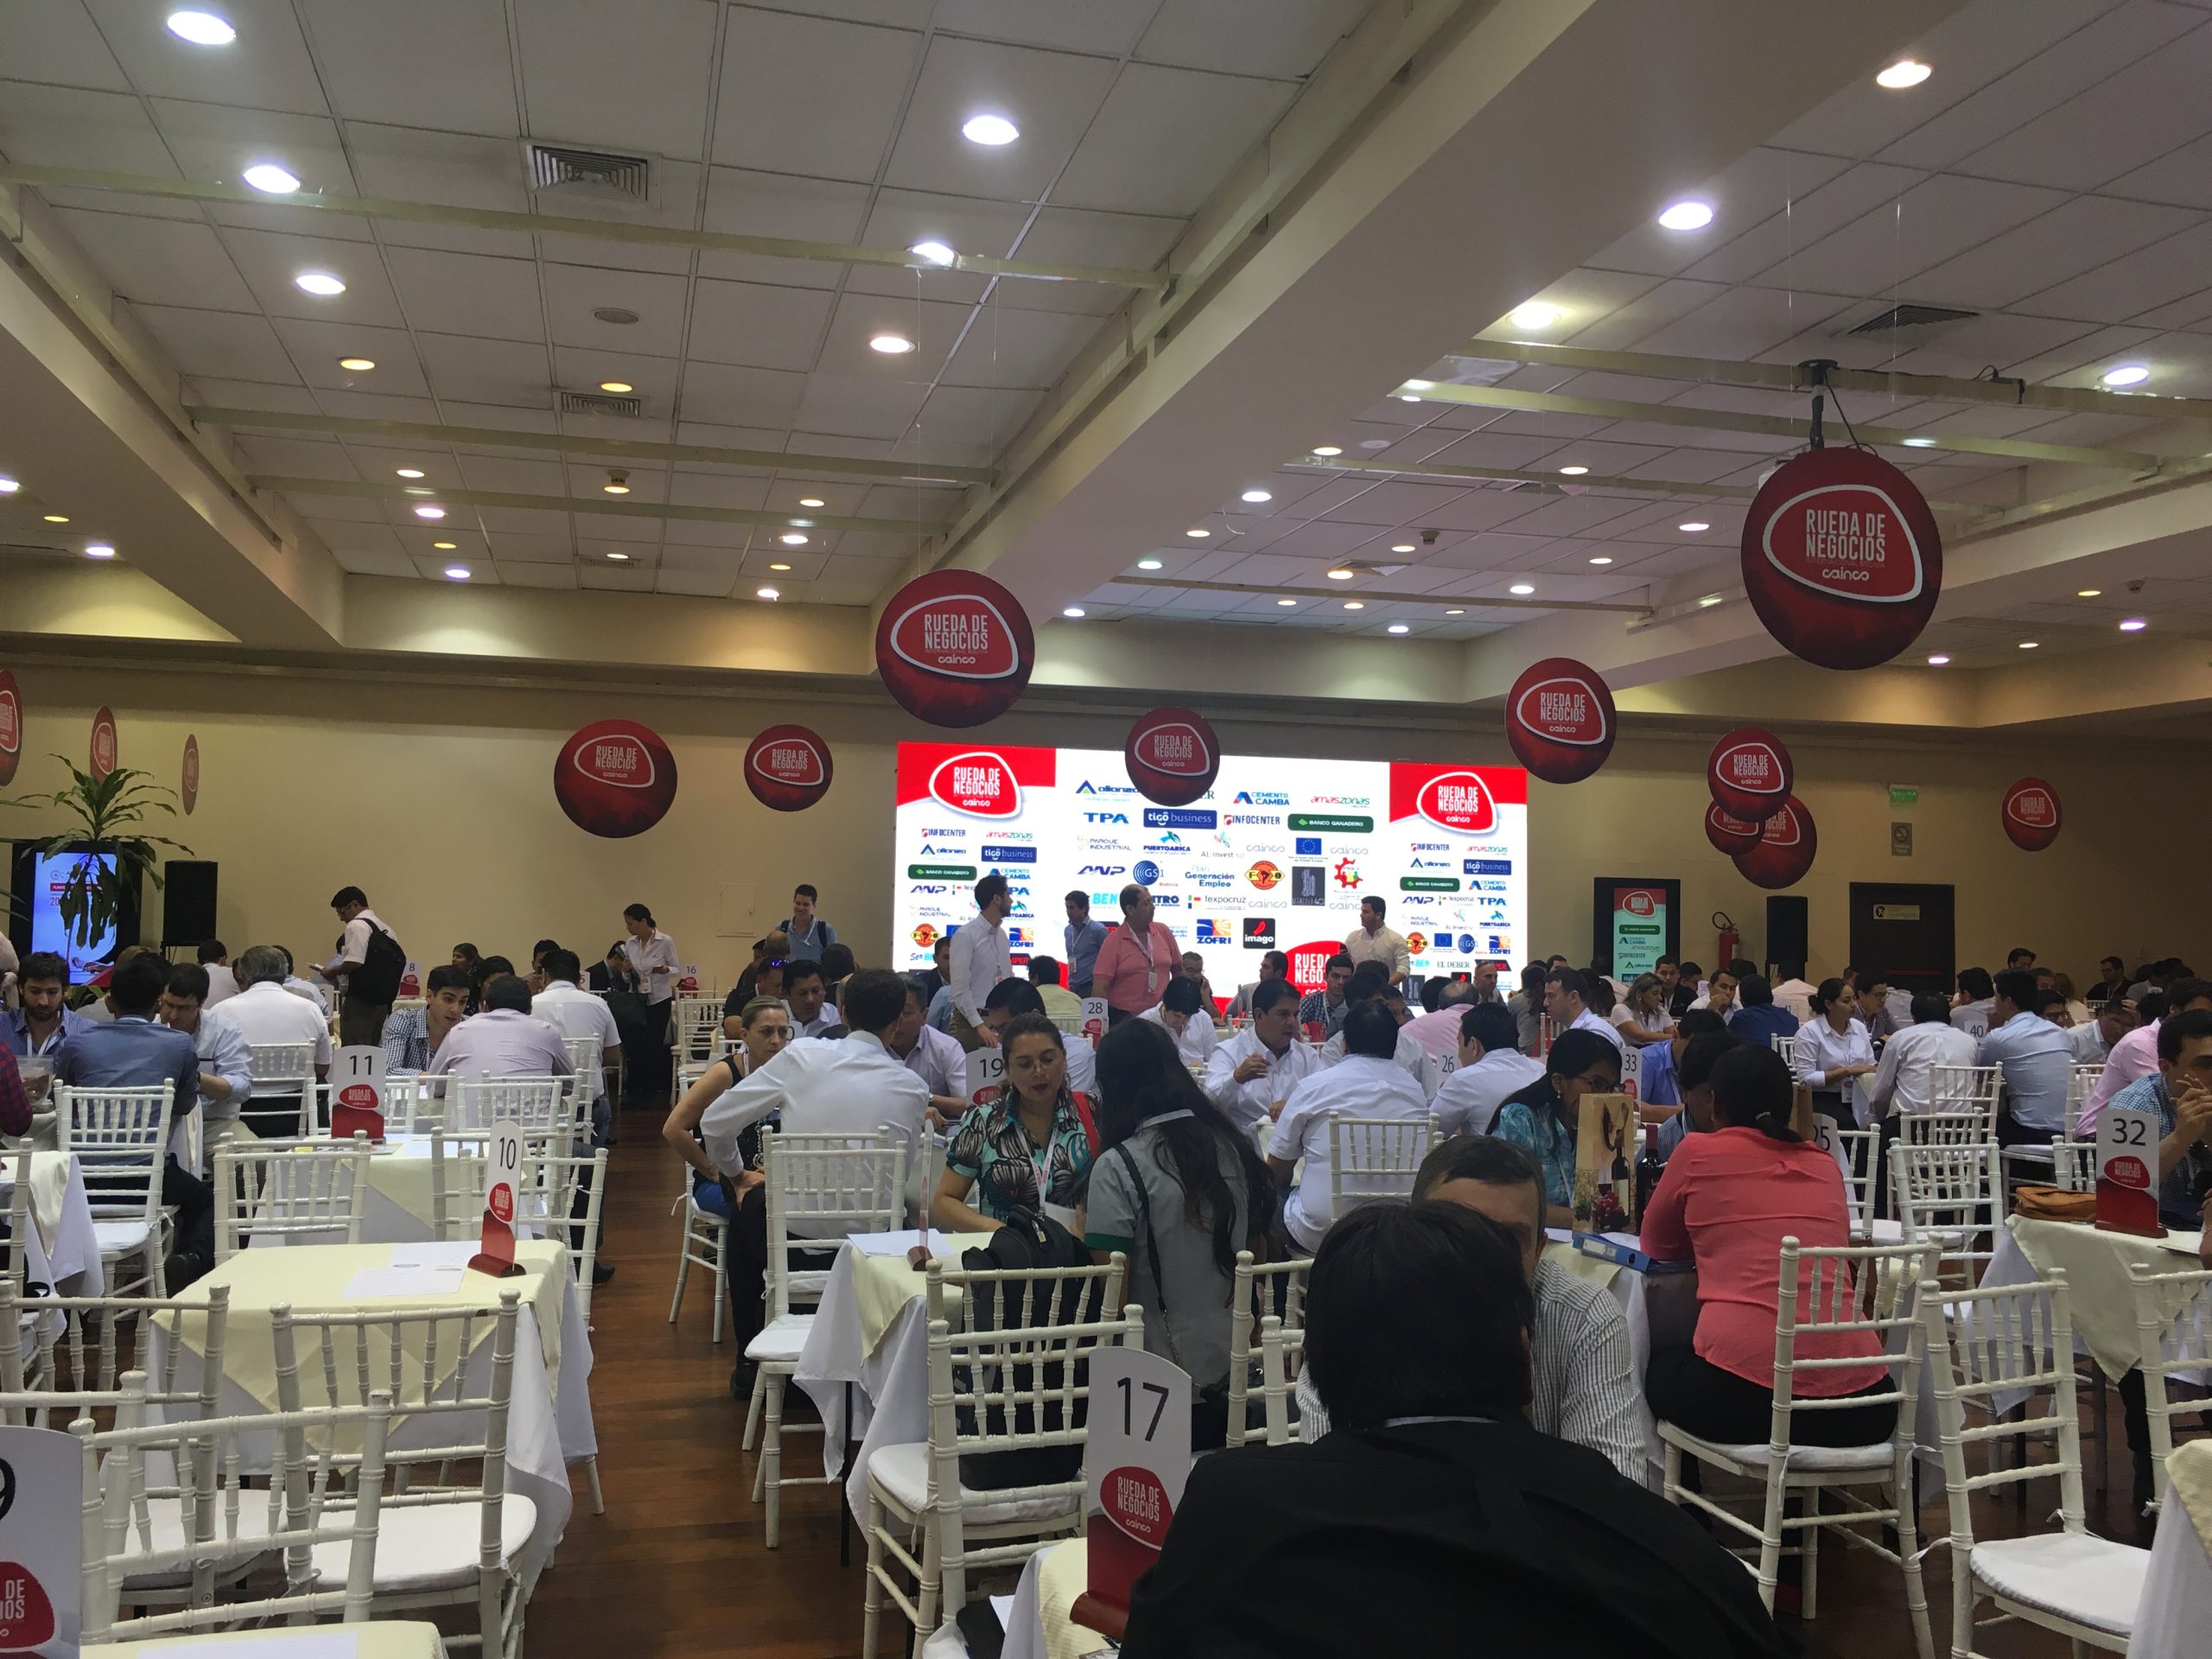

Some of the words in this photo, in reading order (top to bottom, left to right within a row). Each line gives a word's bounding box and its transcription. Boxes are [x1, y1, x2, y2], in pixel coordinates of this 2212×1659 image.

[1806, 509, 1859, 537] RUEDA
[1866, 513, 1885, 537] DE
[1806, 534, 1885, 562] NEGOCIOS
[1822, 567, 1869, 581] cainco
[925, 613, 968, 632] RUEDA
[972, 615, 988, 632] DE
[925, 632, 988, 650] NEGOCIOS
[938, 654, 976, 664] cainco
[1541, 692, 1571, 708] RUEDA
[1574, 694, 1586, 709] DE
[1541, 706, 1586, 721] NEGOCIOS
[1154, 734, 1180, 747] RUEDA
[1183, 736, 1192, 747] DE
[596, 745, 624, 759] RUEDA
[626, 747, 638, 759] DE
[772, 748, 796, 760] RUEDA
[798, 750, 808, 760] DE
[1154, 746, 1192, 758] NEGOCIOS
[594, 756, 637, 770] NEGOCIOS
[772, 759, 808, 770] NEGOCIOS
[1733, 754, 1758, 766] RUEDA
[1759, 754, 1768, 766] DE
[954, 766, 985, 781] RUEDA
[988, 768, 1000, 782] DE
[1733, 765, 1769, 776] NEGOCIOS
[953, 780, 1000, 795] NEGOCIOS
[1438, 785, 1465, 798] RUEDA
[1468, 786, 1478, 799] DE
[963, 798, 990, 807] cainco
[1438, 798, 1478, 812] NEGOCIOS
[1084, 812, 1129, 824] TPA
[1171, 813, 1211, 823] business
[1232, 815, 1280, 825] INFOCENTER
[1765, 819, 1786, 830] OCIOS
[1002, 849, 1033, 858] business
[1246, 843, 1285, 853] cainco
[1331, 847, 1369, 855] cainco
[1481, 861, 1509, 871] business
[1185, 872, 1235, 880] Generación
[1009, 887, 1030, 895] PA
[1205, 895, 1246, 904] fexpocruz
[1329, 901, 1362, 910] cainc
[1477, 897, 1507, 906] TPA
[1245, 934, 1274, 944] imago
[409, 963, 416, 972] 8
[686, 965, 696, 974] 16
[1295, 969, 1326, 983] NEGO
[1088, 1002, 1103, 1014] 28
[1969, 1025, 1984, 1038] 40
[349, 1055, 372, 1076] 11
[979, 1058, 1003, 1077] 19
[1442, 1055, 1455, 1073] 26
[1624, 1053, 1637, 1071] 33
[2112, 1118, 2146, 1146] 32
[499, 1136, 517, 1170] 10
[1117, 1376, 1169, 1442] 17
[1117, 1476, 1147, 1503] RUEDA
[1148, 1485, 1160, 1505] DE
[1117, 1492, 1160, 1522] NEGOCIOS
[1126, 1517, 1152, 1534] cainco
[5, 1579, 25, 1599] DE
